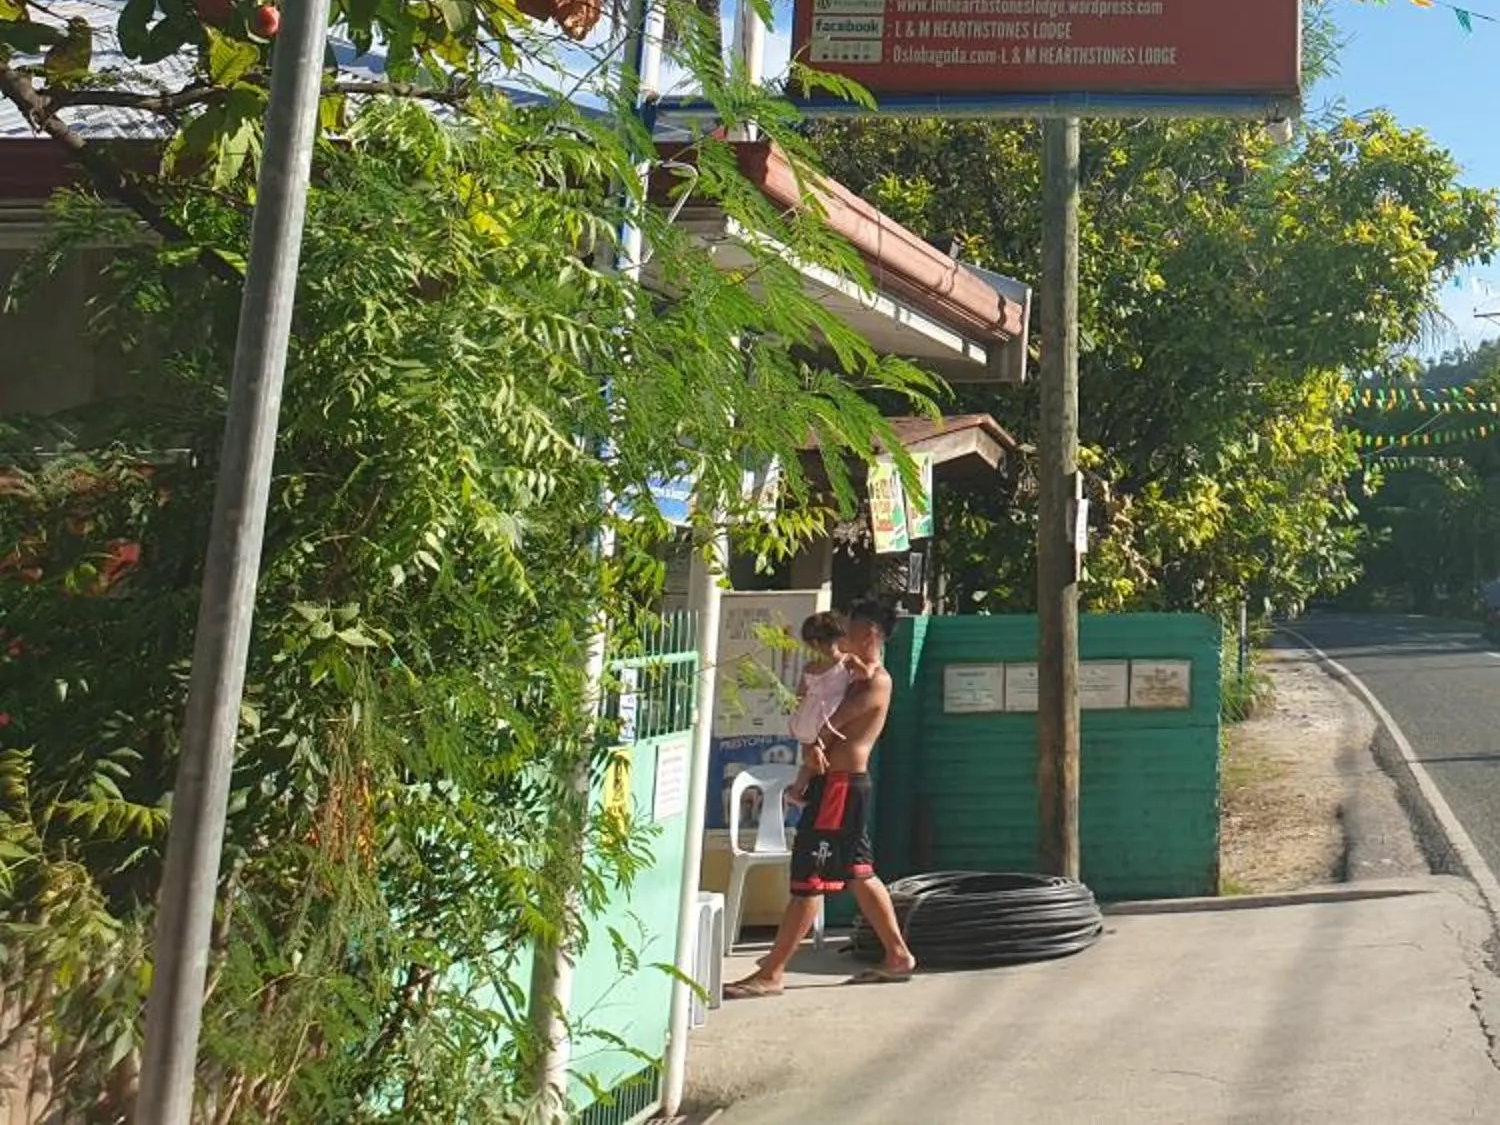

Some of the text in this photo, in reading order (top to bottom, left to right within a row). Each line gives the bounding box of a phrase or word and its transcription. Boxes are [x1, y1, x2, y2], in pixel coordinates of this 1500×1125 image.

[815, 18, 879, 35] facebook
[894, 20, 902, 38] L
[904, 21, 916, 39] &
[918, 21, 931, 39] M
[933, 21, 1031, 39] HEARTHSTONES
[1032, 22, 1073, 40] LODGE
[1011, 46, 1022, 64] &
[1024, 46, 1037, 64] M
[1038, 47, 1136, 65] HEARTHSTONES
[1138, 47, 1178, 66] LODGE
